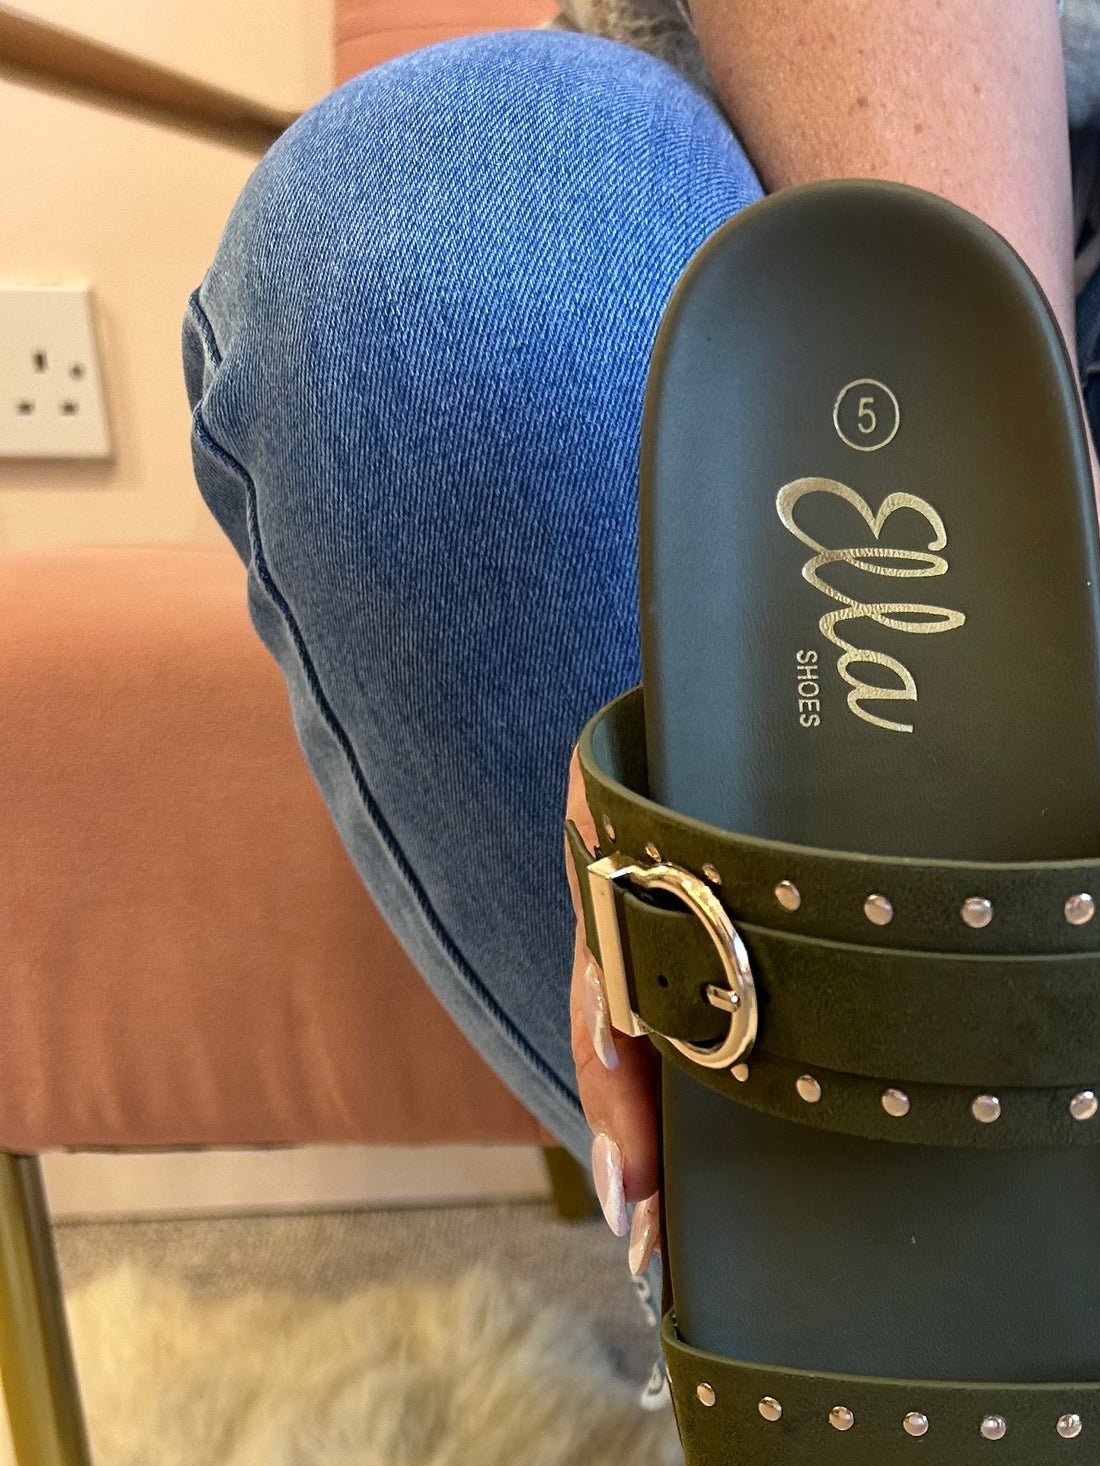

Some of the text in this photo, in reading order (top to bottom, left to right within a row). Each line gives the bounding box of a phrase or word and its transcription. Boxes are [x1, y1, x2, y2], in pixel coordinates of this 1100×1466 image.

[857, 397, 877, 434] 5
[776, 477, 966, 733] Ella
[796, 650, 821, 728] SHOES
